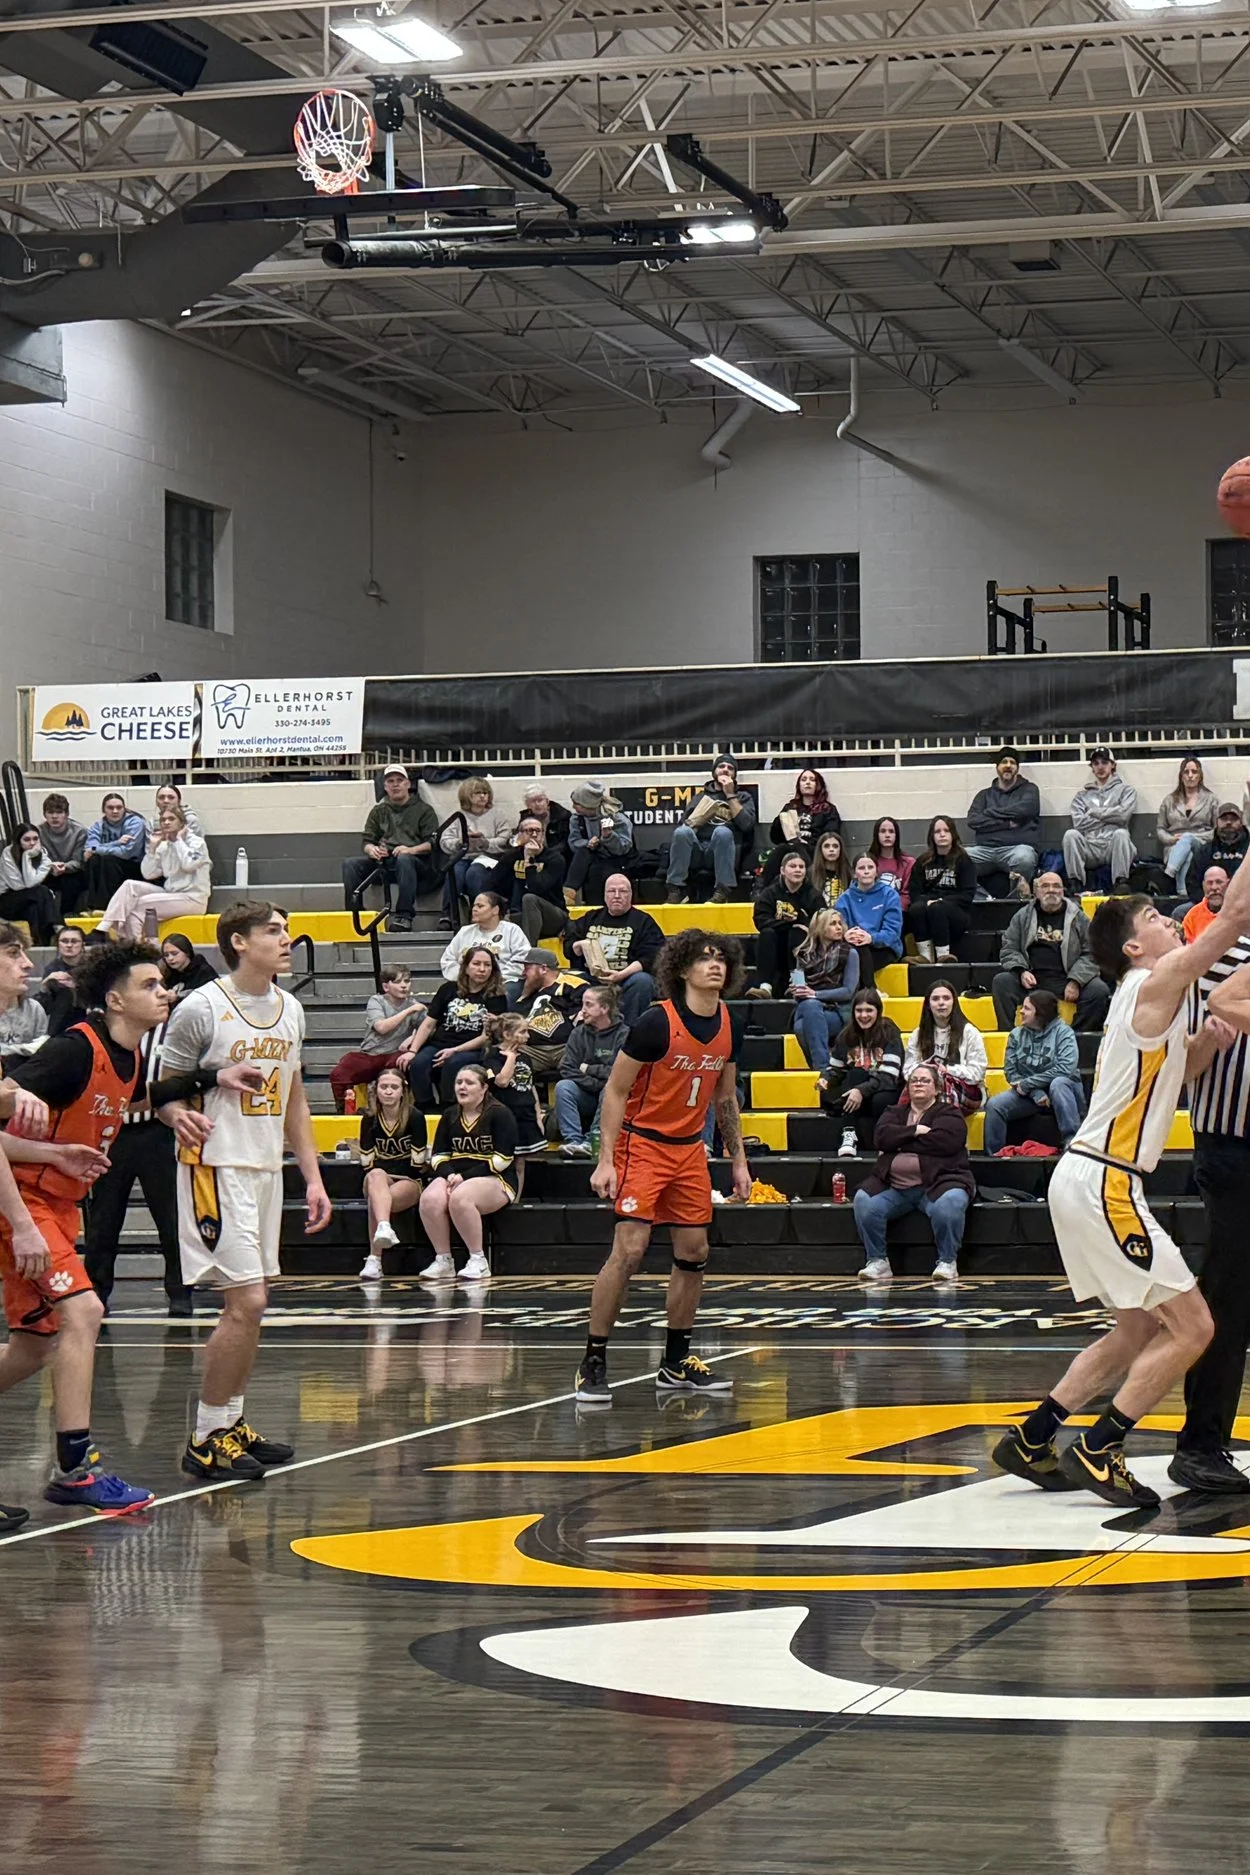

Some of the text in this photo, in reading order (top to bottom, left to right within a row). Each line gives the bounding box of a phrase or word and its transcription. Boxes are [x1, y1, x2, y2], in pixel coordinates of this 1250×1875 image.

[254, 691, 353, 703] ELLERHORST
[101, 705, 192, 719] GREAT LAKES
[277, 704, 327, 712] DENTAL
[100, 721, 191, 741] CHEESE
[220, 735, 344, 746] www.ellerhorstdental.com
[625, 810, 684, 825] TUDENT
[230, 1037, 293, 1063] G-MEN
[697, 1054, 726, 1071] Fall
[686, 1076, 702, 1107] 1
[484, 1315, 1115, 1330] ARCHIONE
